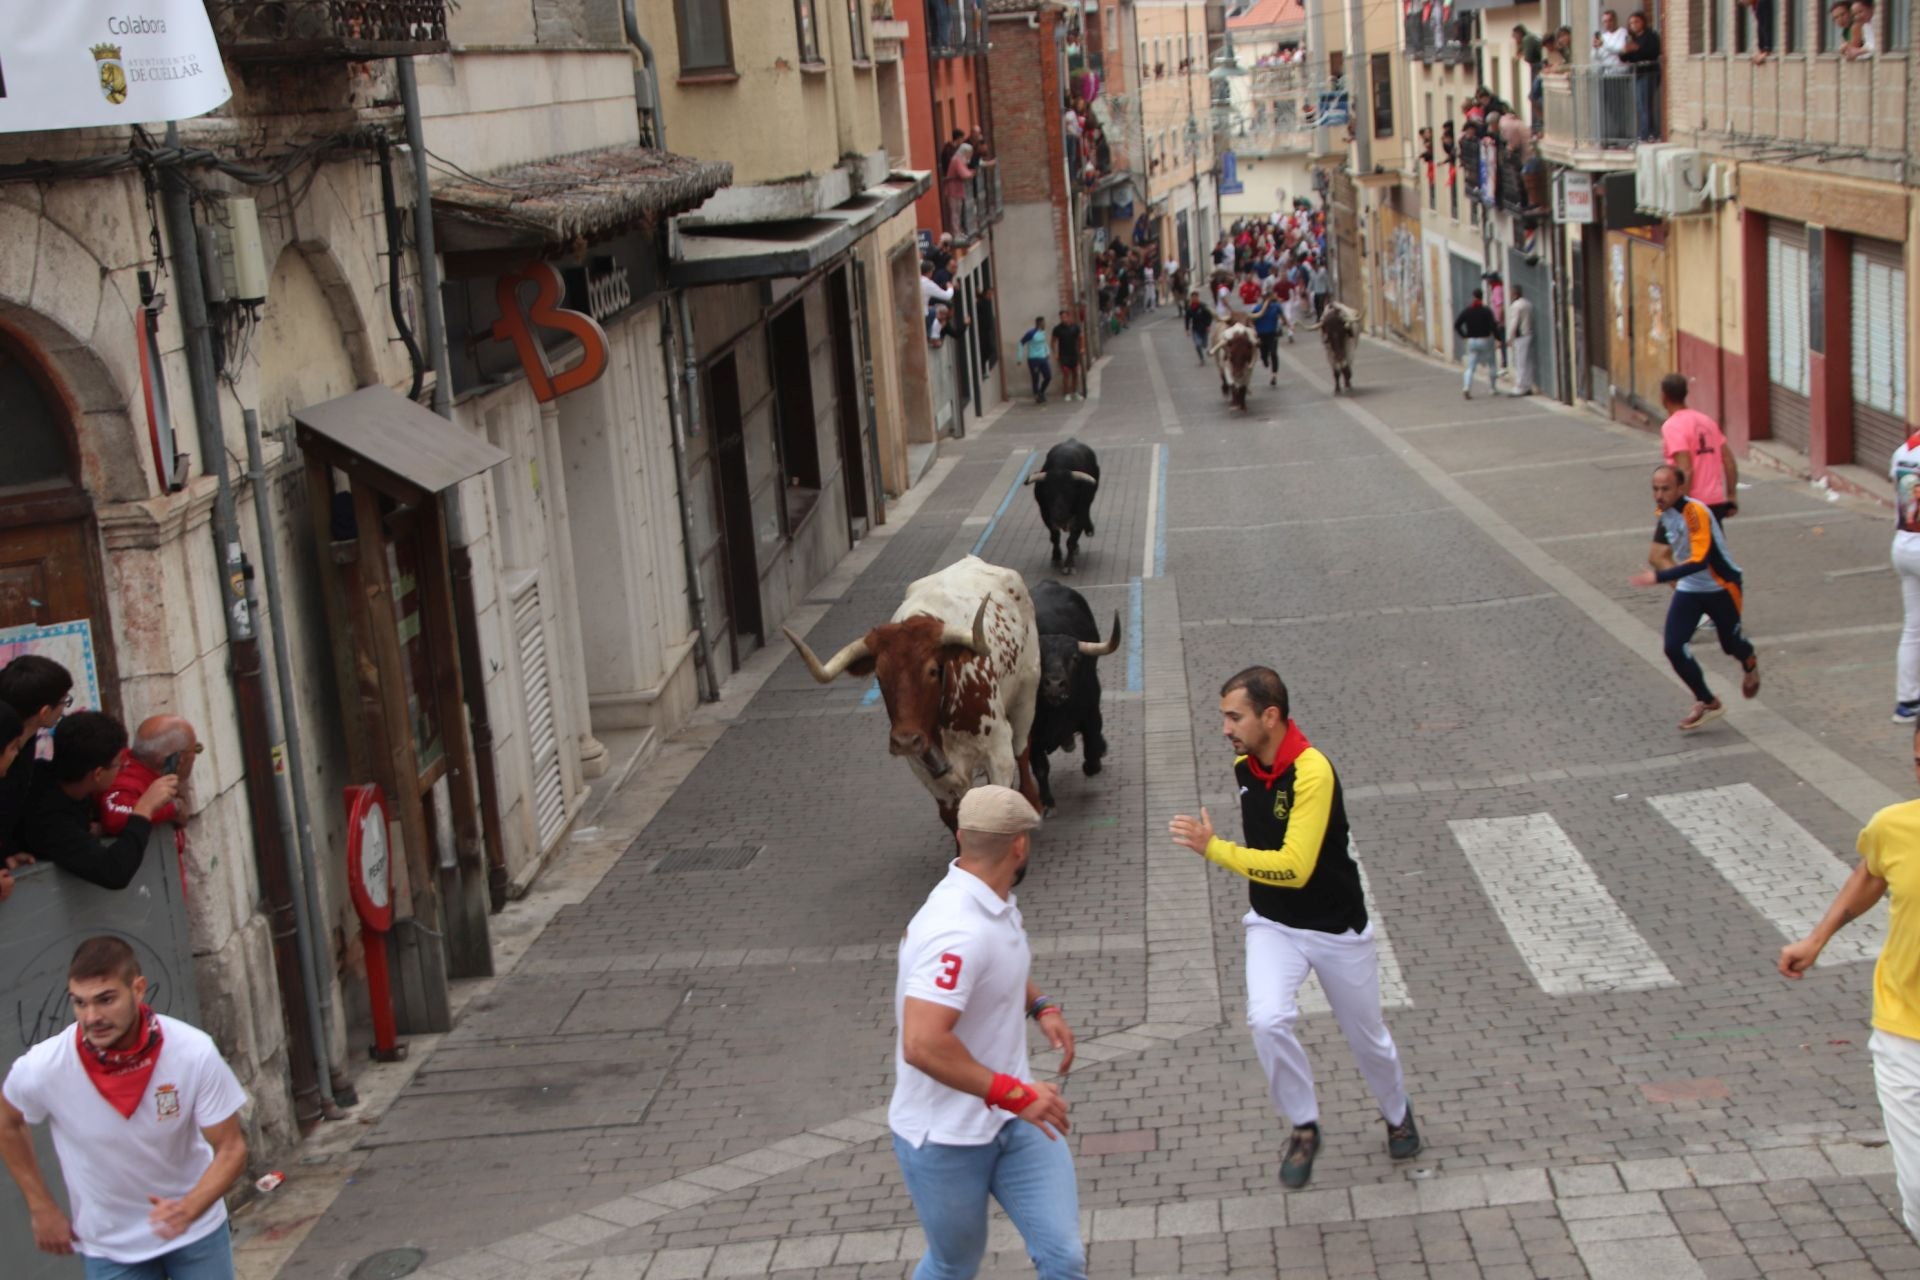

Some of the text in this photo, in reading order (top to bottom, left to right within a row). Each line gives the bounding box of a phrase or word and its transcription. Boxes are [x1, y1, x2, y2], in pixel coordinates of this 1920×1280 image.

[108, 15, 167, 35] Colabora
[130, 68, 147, 82] DE
[935, 952, 963, 991] 3
